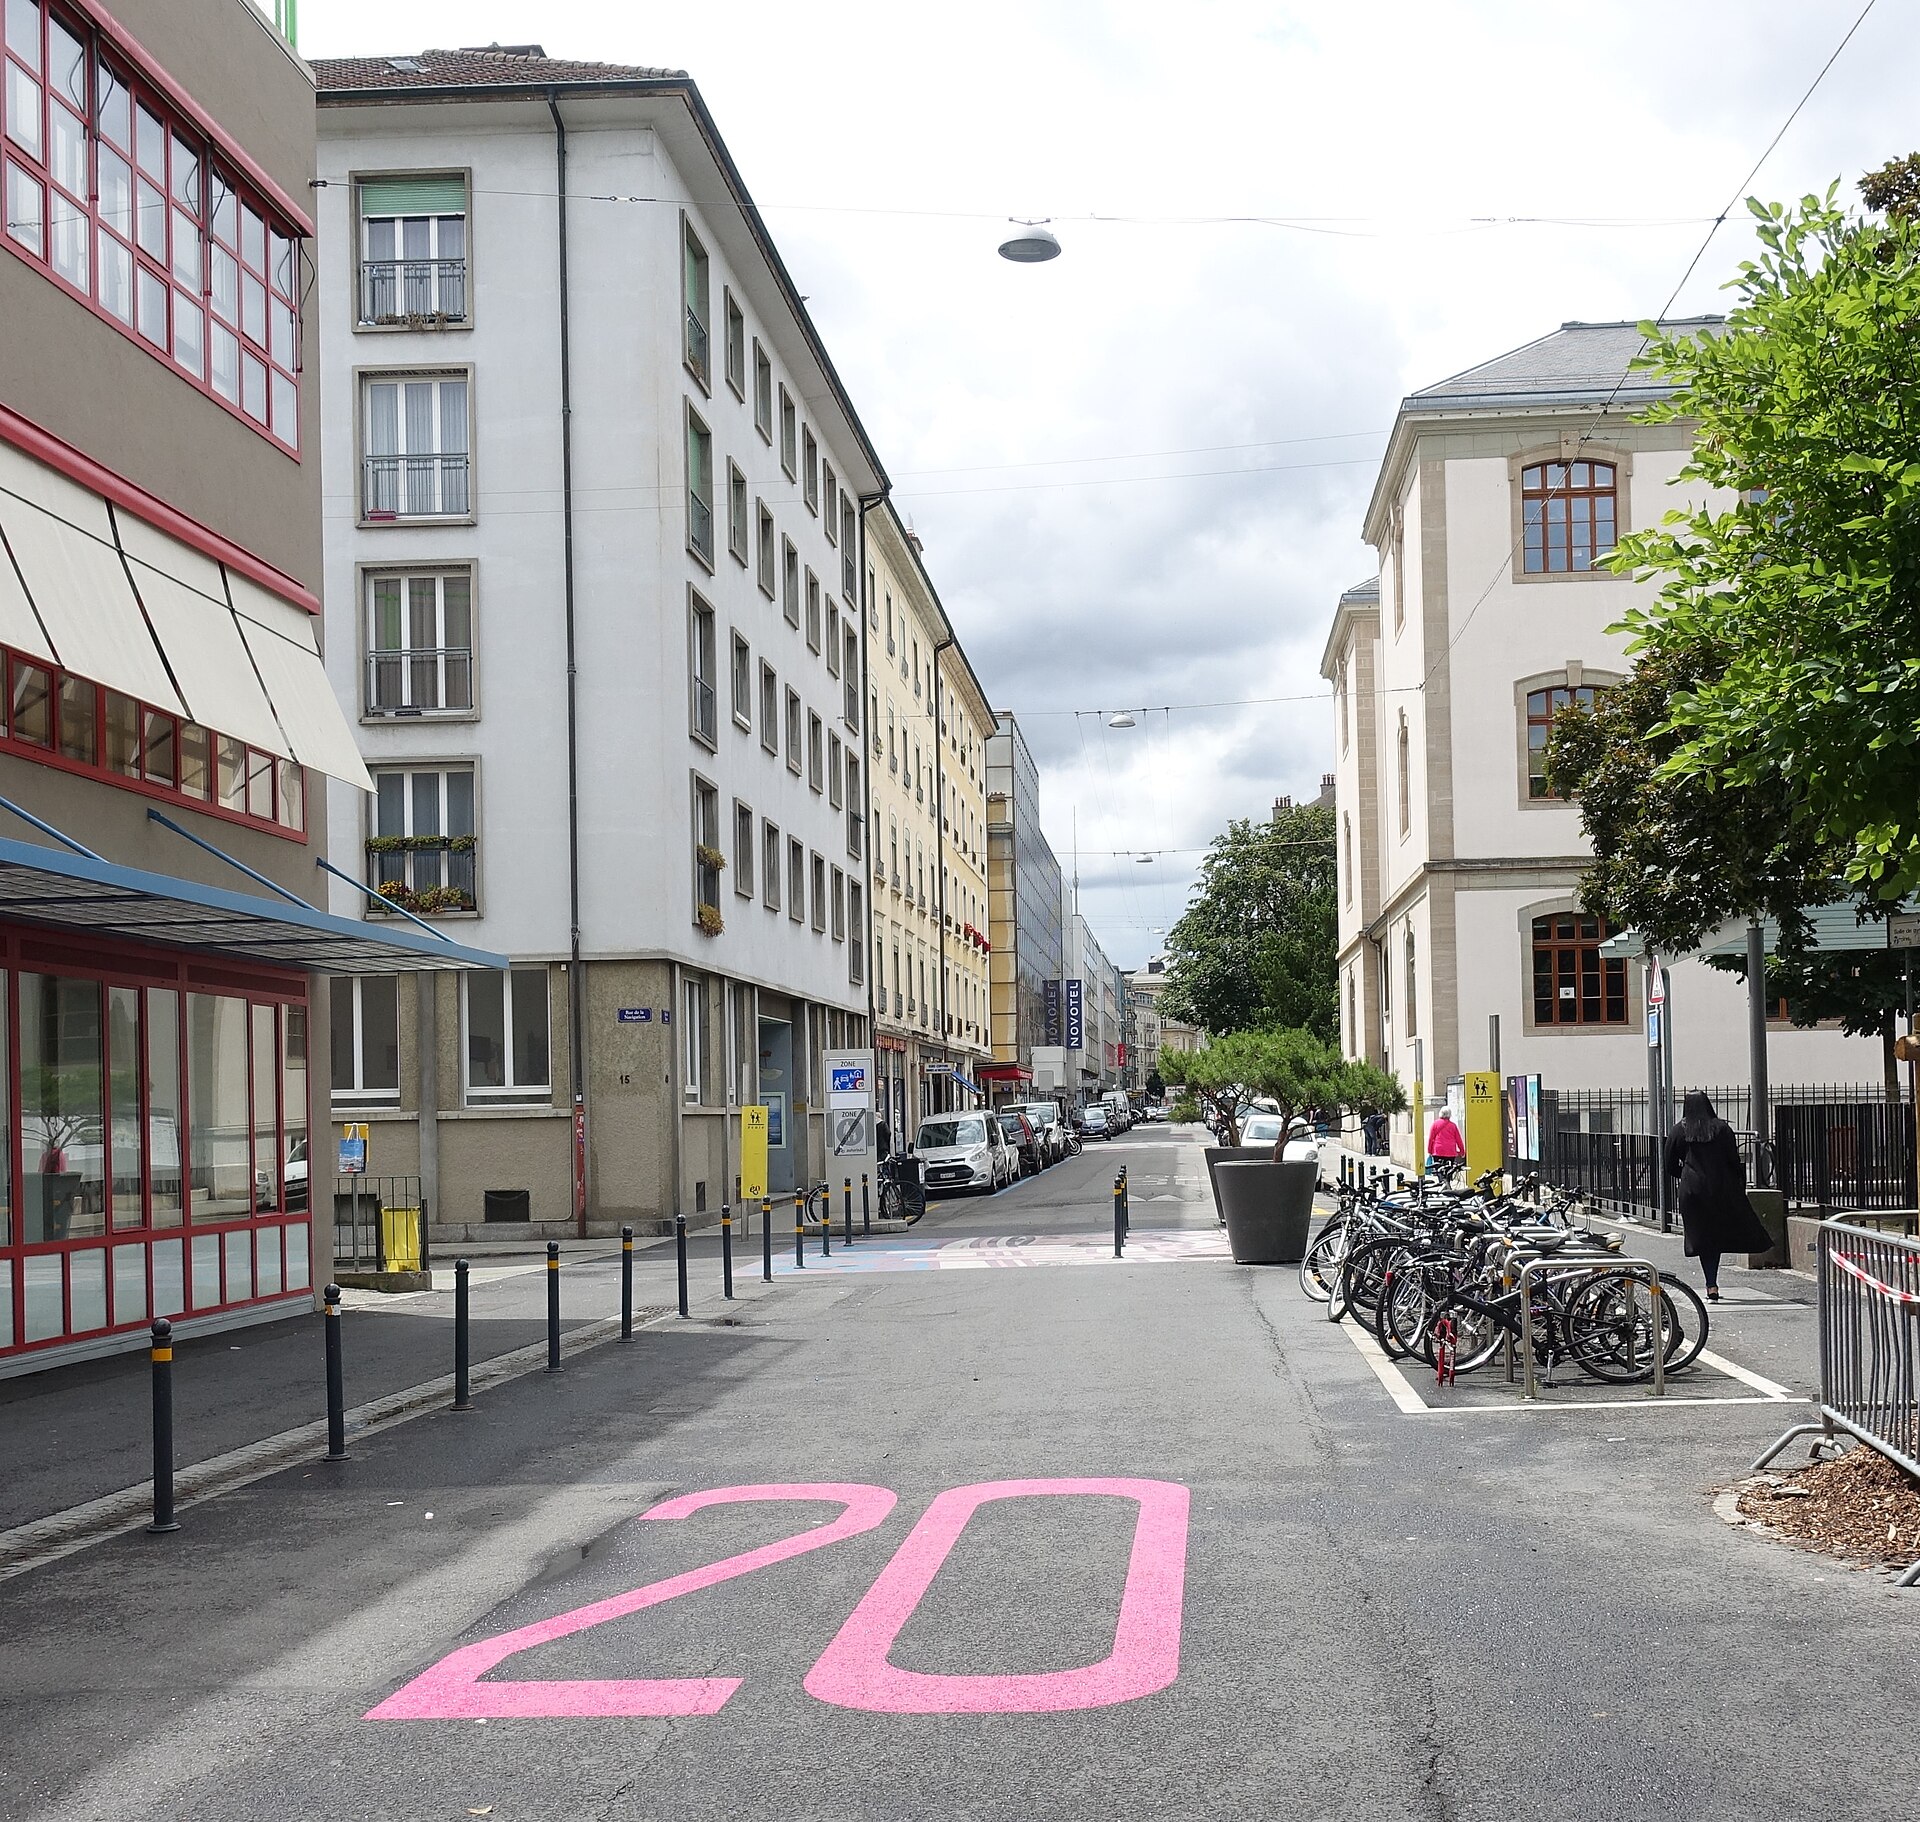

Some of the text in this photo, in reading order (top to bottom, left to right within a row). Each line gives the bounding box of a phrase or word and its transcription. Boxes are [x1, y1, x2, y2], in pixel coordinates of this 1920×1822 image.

[1069, 982, 1079, 1046] NOVOTEL
[620, 1075, 630, 1084] 15
[362, 1477, 1190, 1719] 20
